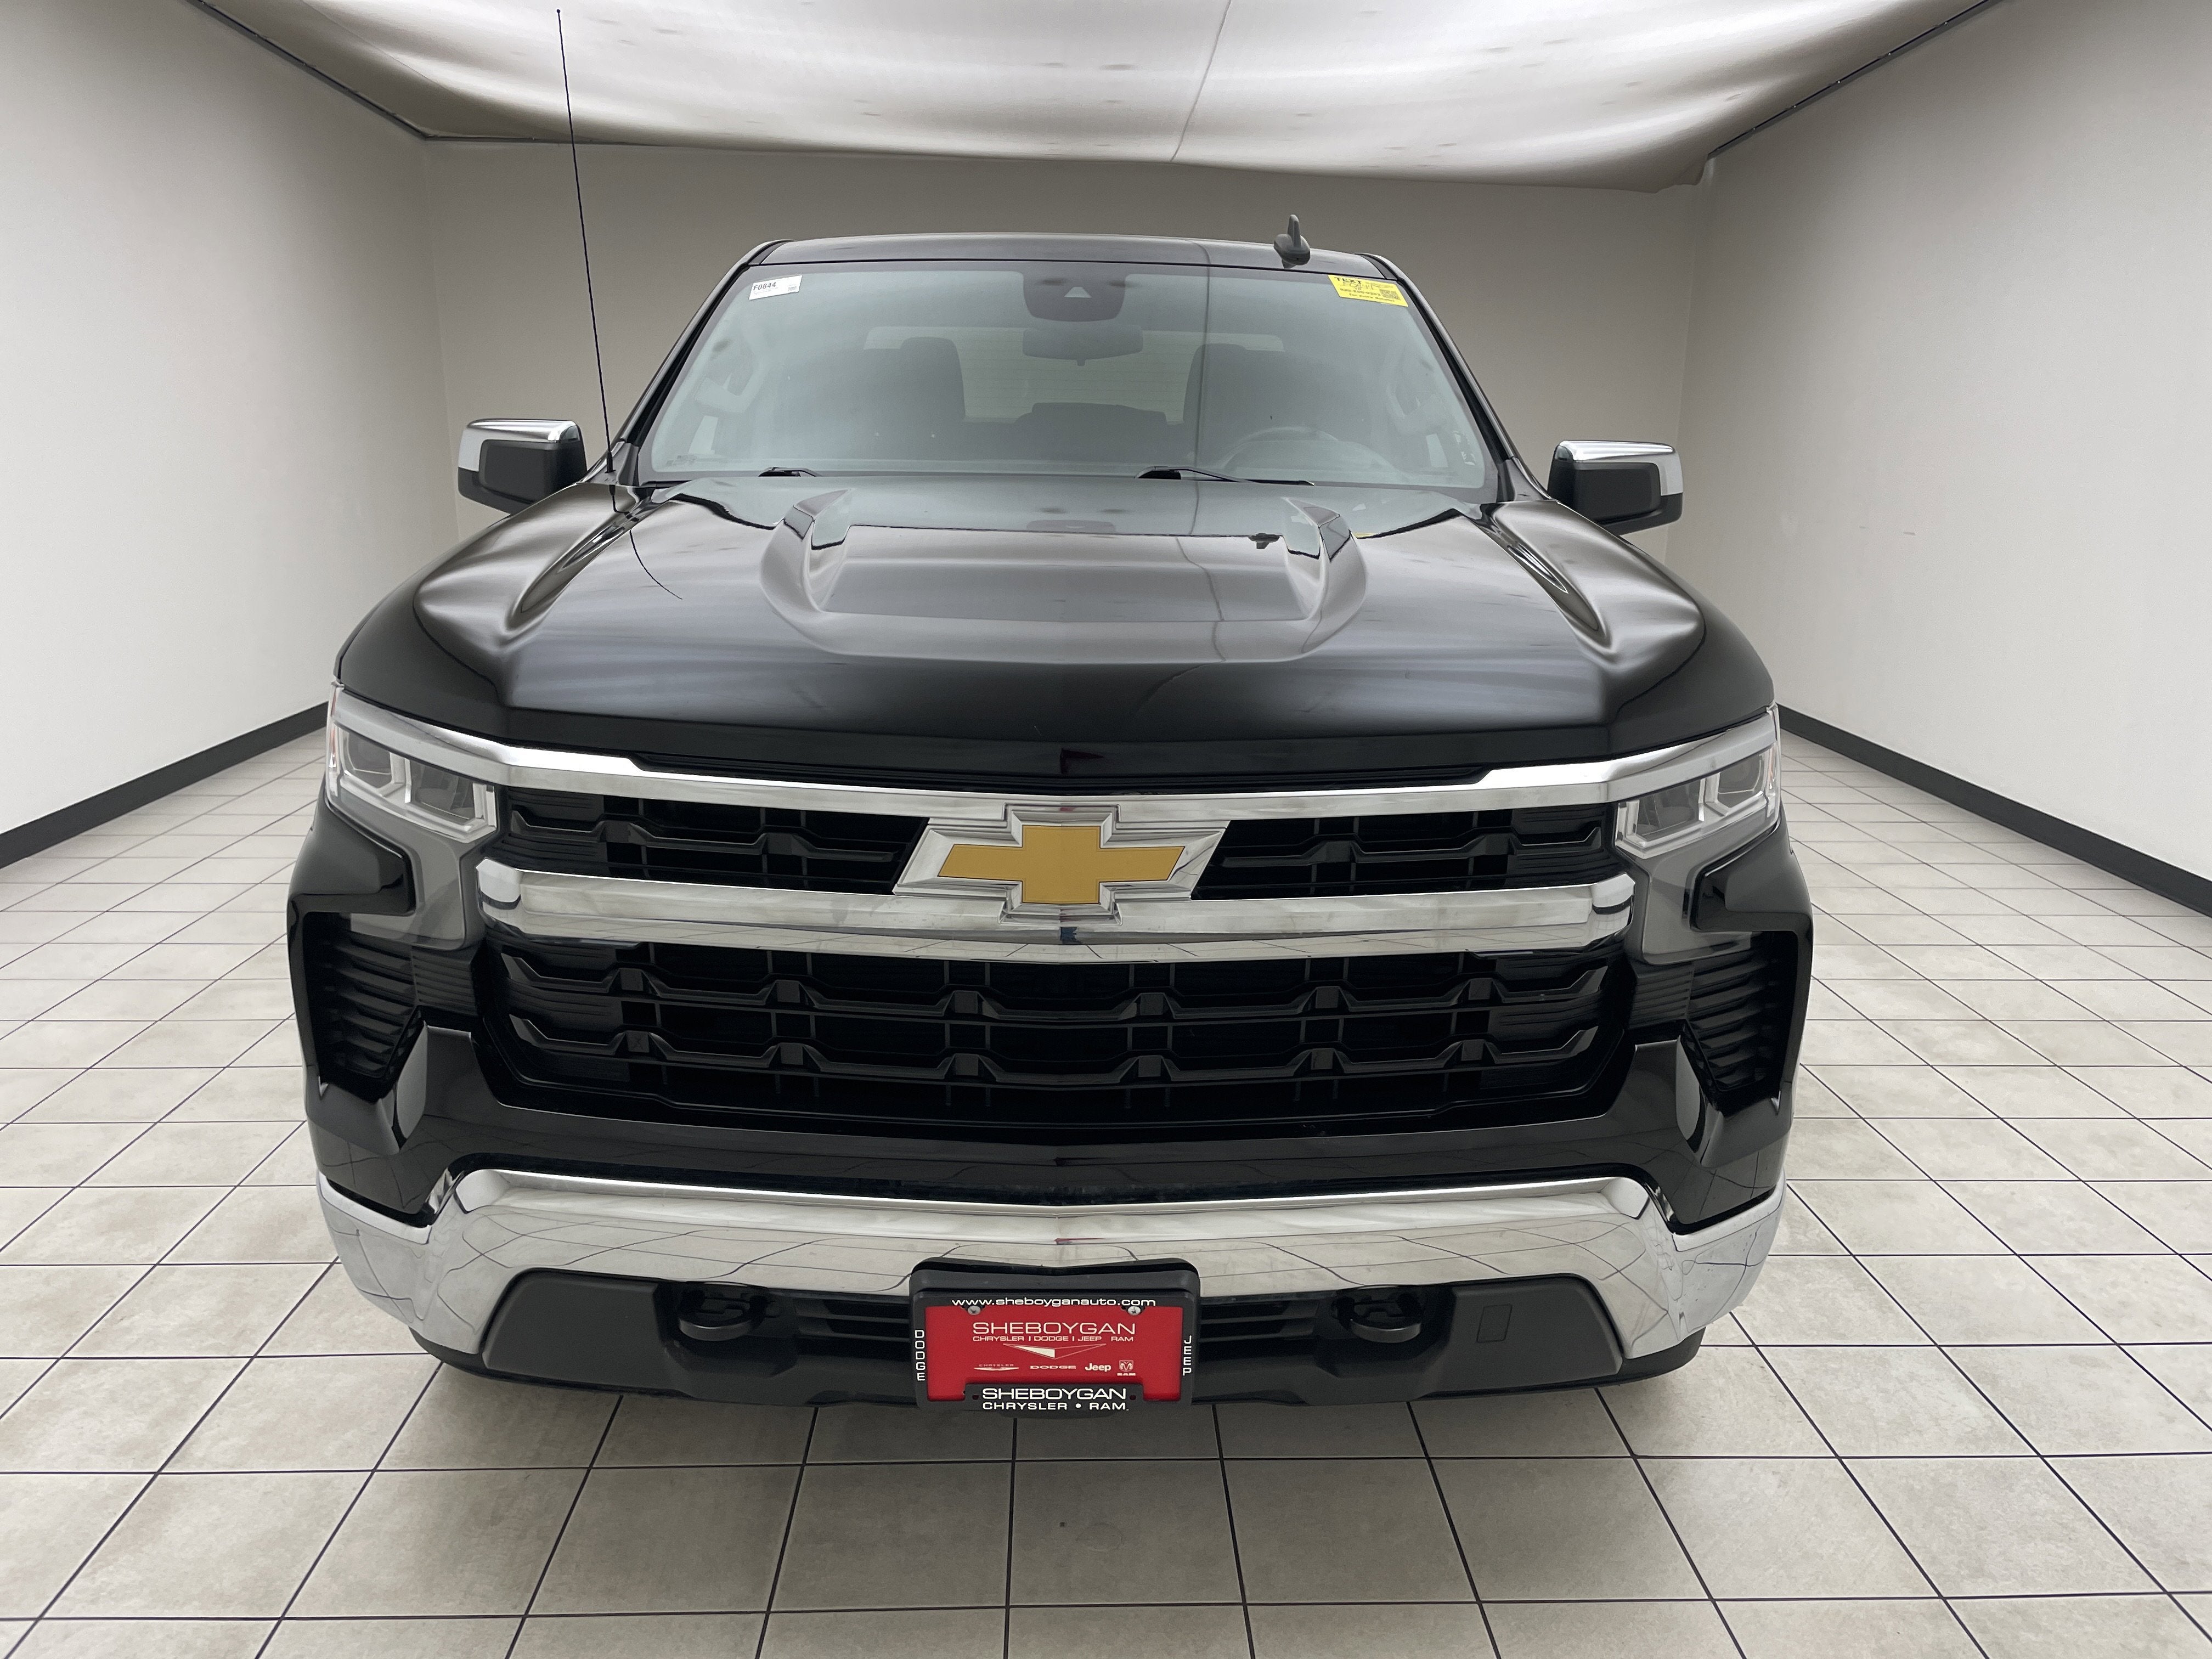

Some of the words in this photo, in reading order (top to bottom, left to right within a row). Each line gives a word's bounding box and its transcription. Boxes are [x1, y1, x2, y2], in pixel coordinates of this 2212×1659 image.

[753, 282, 776, 290] F0844
[951, 1297, 1156, 1307] www.sheboyganauto.com
[973, 1322, 1135, 1335] SHEBOYGAN
[915, 1329, 926, 1381] DODGE
[1182, 1335, 1192, 1376] JEEP
[1085, 1363, 1111, 1372] Jeep
[982, 1388, 1126, 1400] SHEBOYGAN
[983, 1402, 1068, 1410] CHRYSLER
